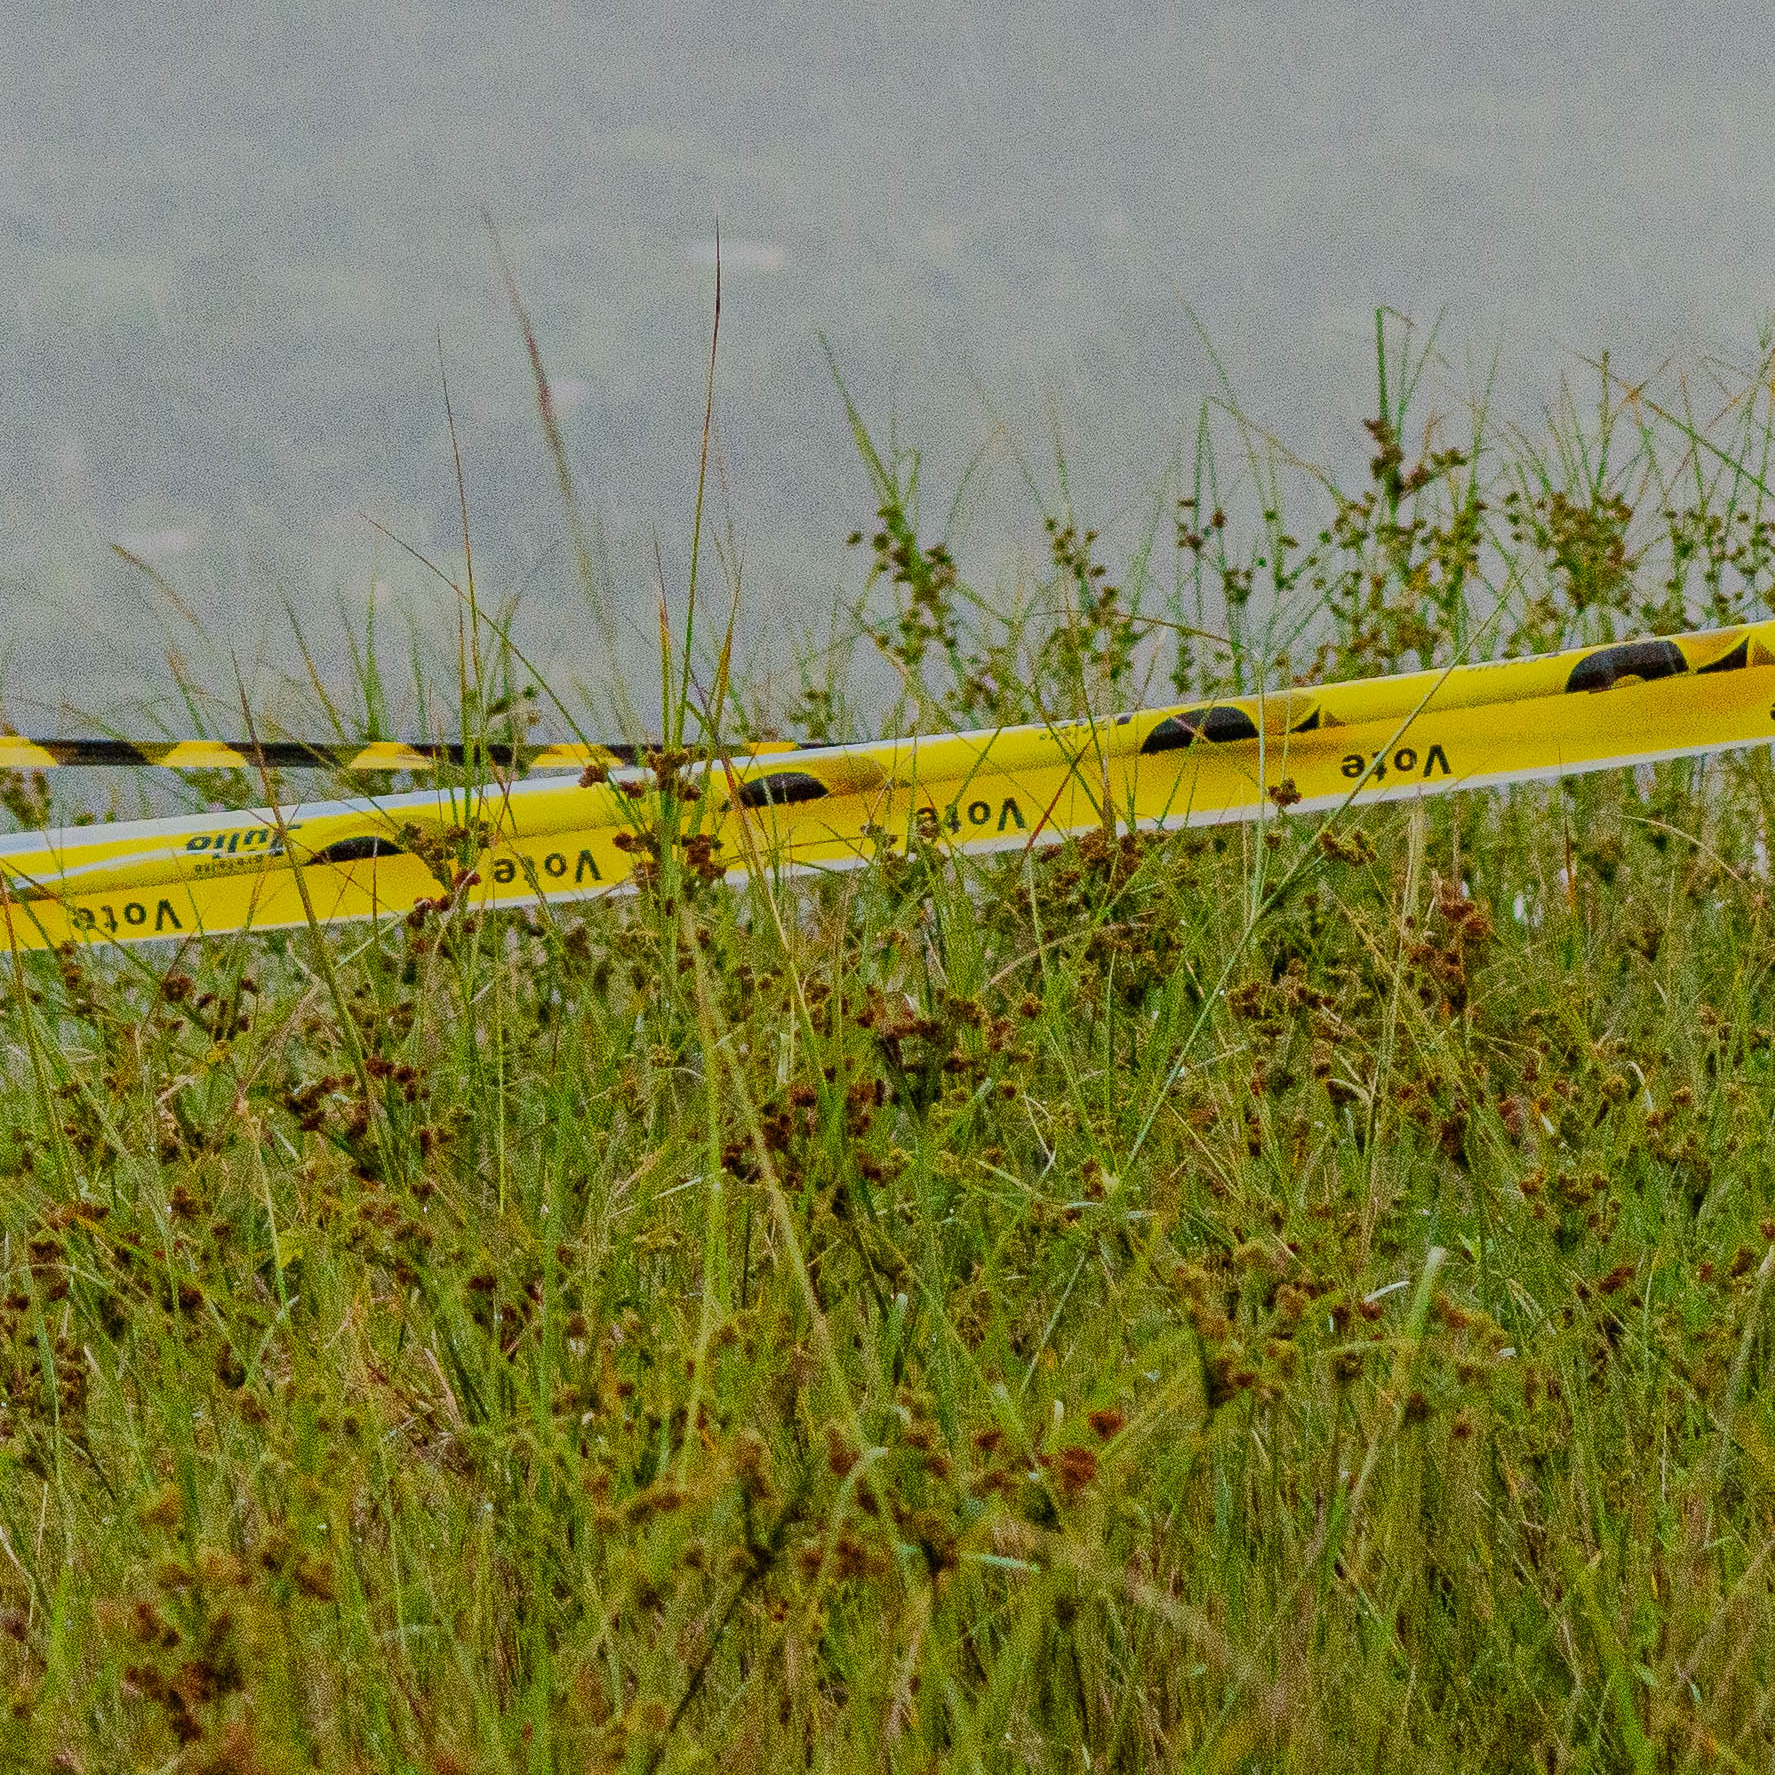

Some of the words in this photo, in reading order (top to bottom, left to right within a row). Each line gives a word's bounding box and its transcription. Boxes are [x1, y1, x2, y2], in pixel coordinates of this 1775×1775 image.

[1340, 744, 1452, 783] Vote
[493, 849, 602, 889] Vote
[72, 898, 183, 934] Vote
